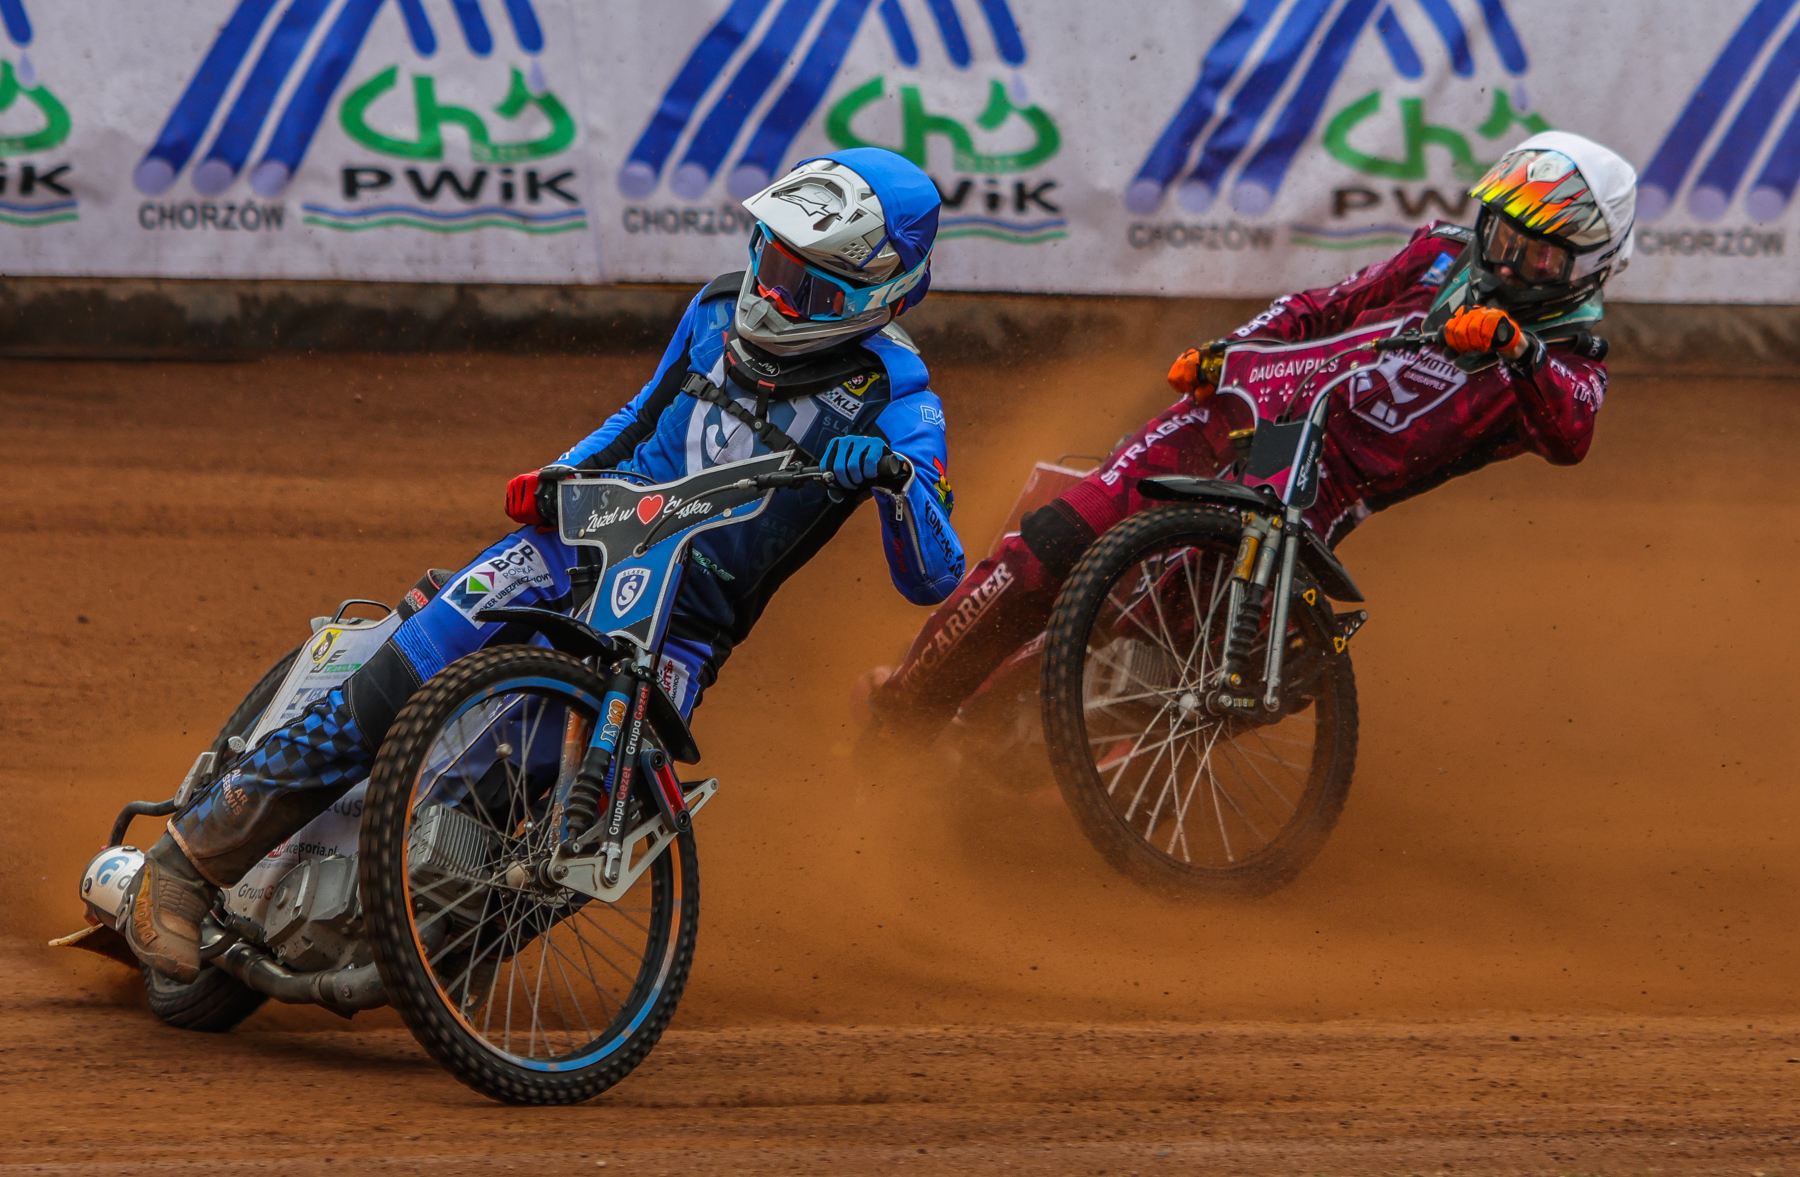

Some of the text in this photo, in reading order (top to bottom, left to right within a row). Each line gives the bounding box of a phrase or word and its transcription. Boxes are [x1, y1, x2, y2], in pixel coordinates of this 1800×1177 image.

[341, 167, 581, 203] PWiK
[934, 178, 1064, 214] iK
[138, 201, 285, 231] CHORZÓW
[622, 205, 757, 234] CHORZÓ
[1331, 187, 1469, 221] PW
[1248, 357, 1341, 385] DAUGAVPILS
[585, 506, 619, 533] Żużel
[618, 508, 635, 522] w
[488, 544, 536, 573] BCP
[625, 686, 650, 755] GrupaGezet
[608, 766, 632, 836] GrupaGezet
